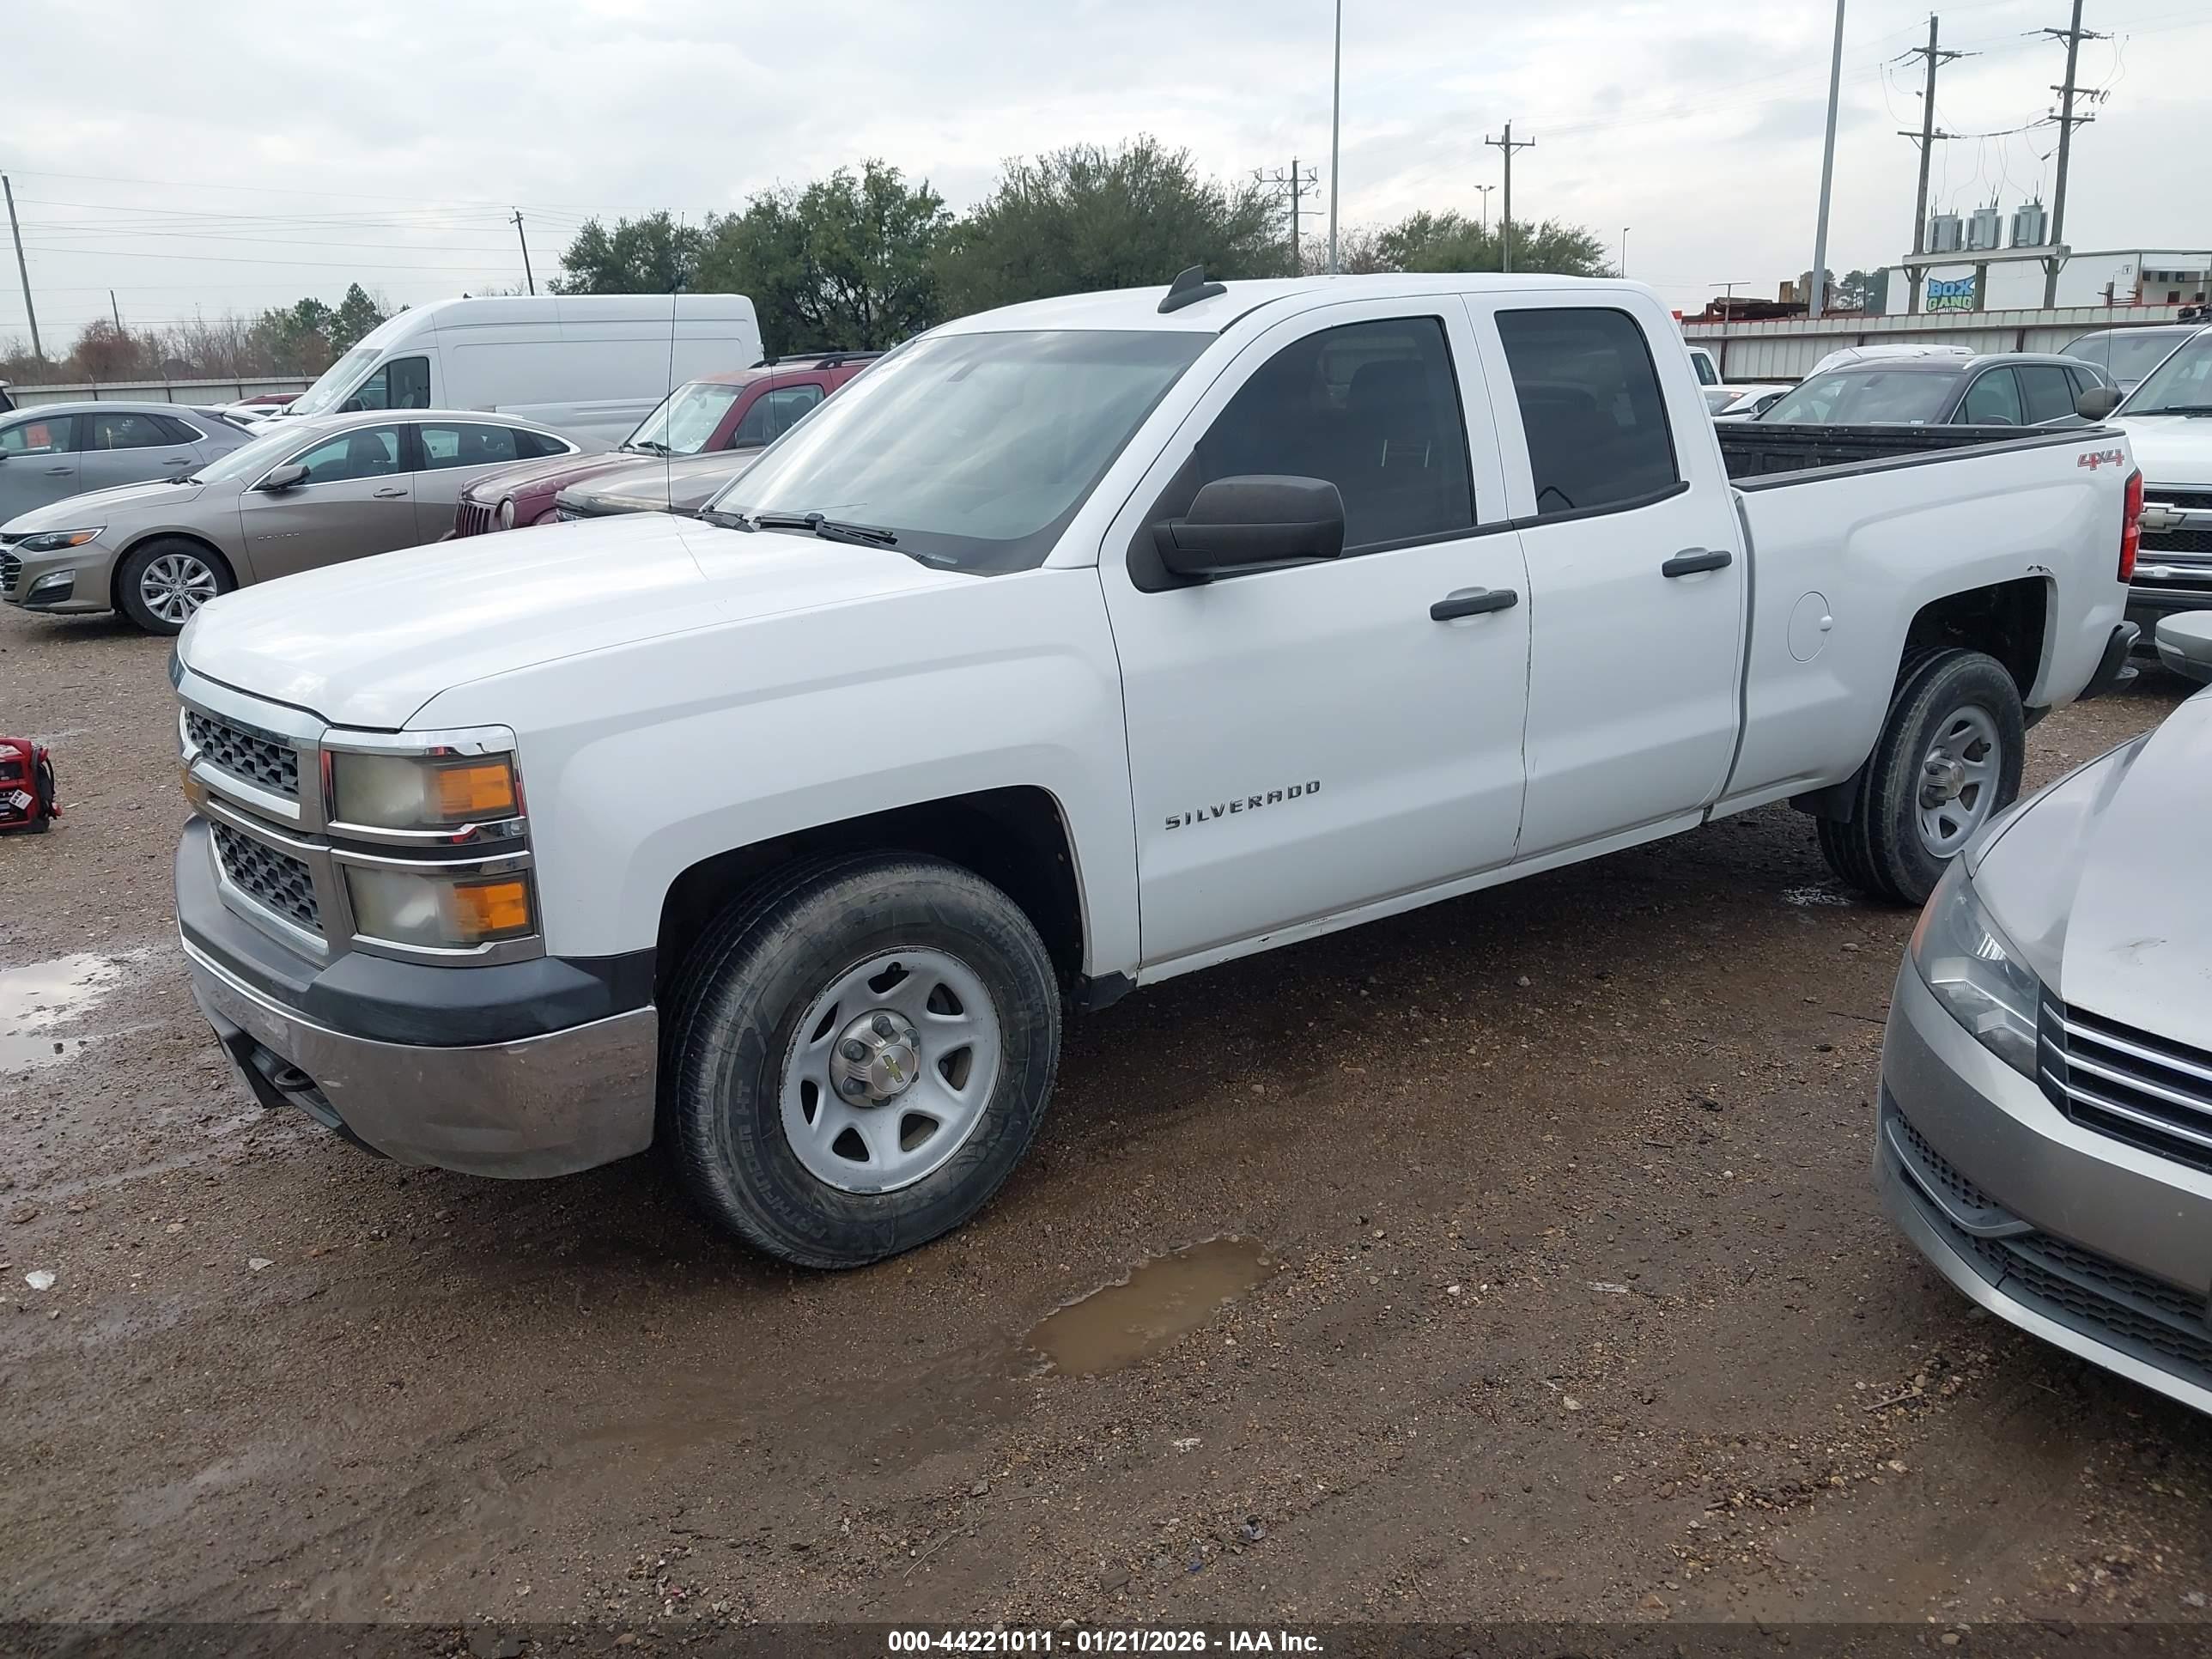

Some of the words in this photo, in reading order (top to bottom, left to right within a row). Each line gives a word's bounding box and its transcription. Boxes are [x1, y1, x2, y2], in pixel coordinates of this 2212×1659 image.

[1929, 275, 1976, 297] BOX
[1926, 295, 1973, 311] GANG
[1164, 779, 1321, 831] SILVERADO
